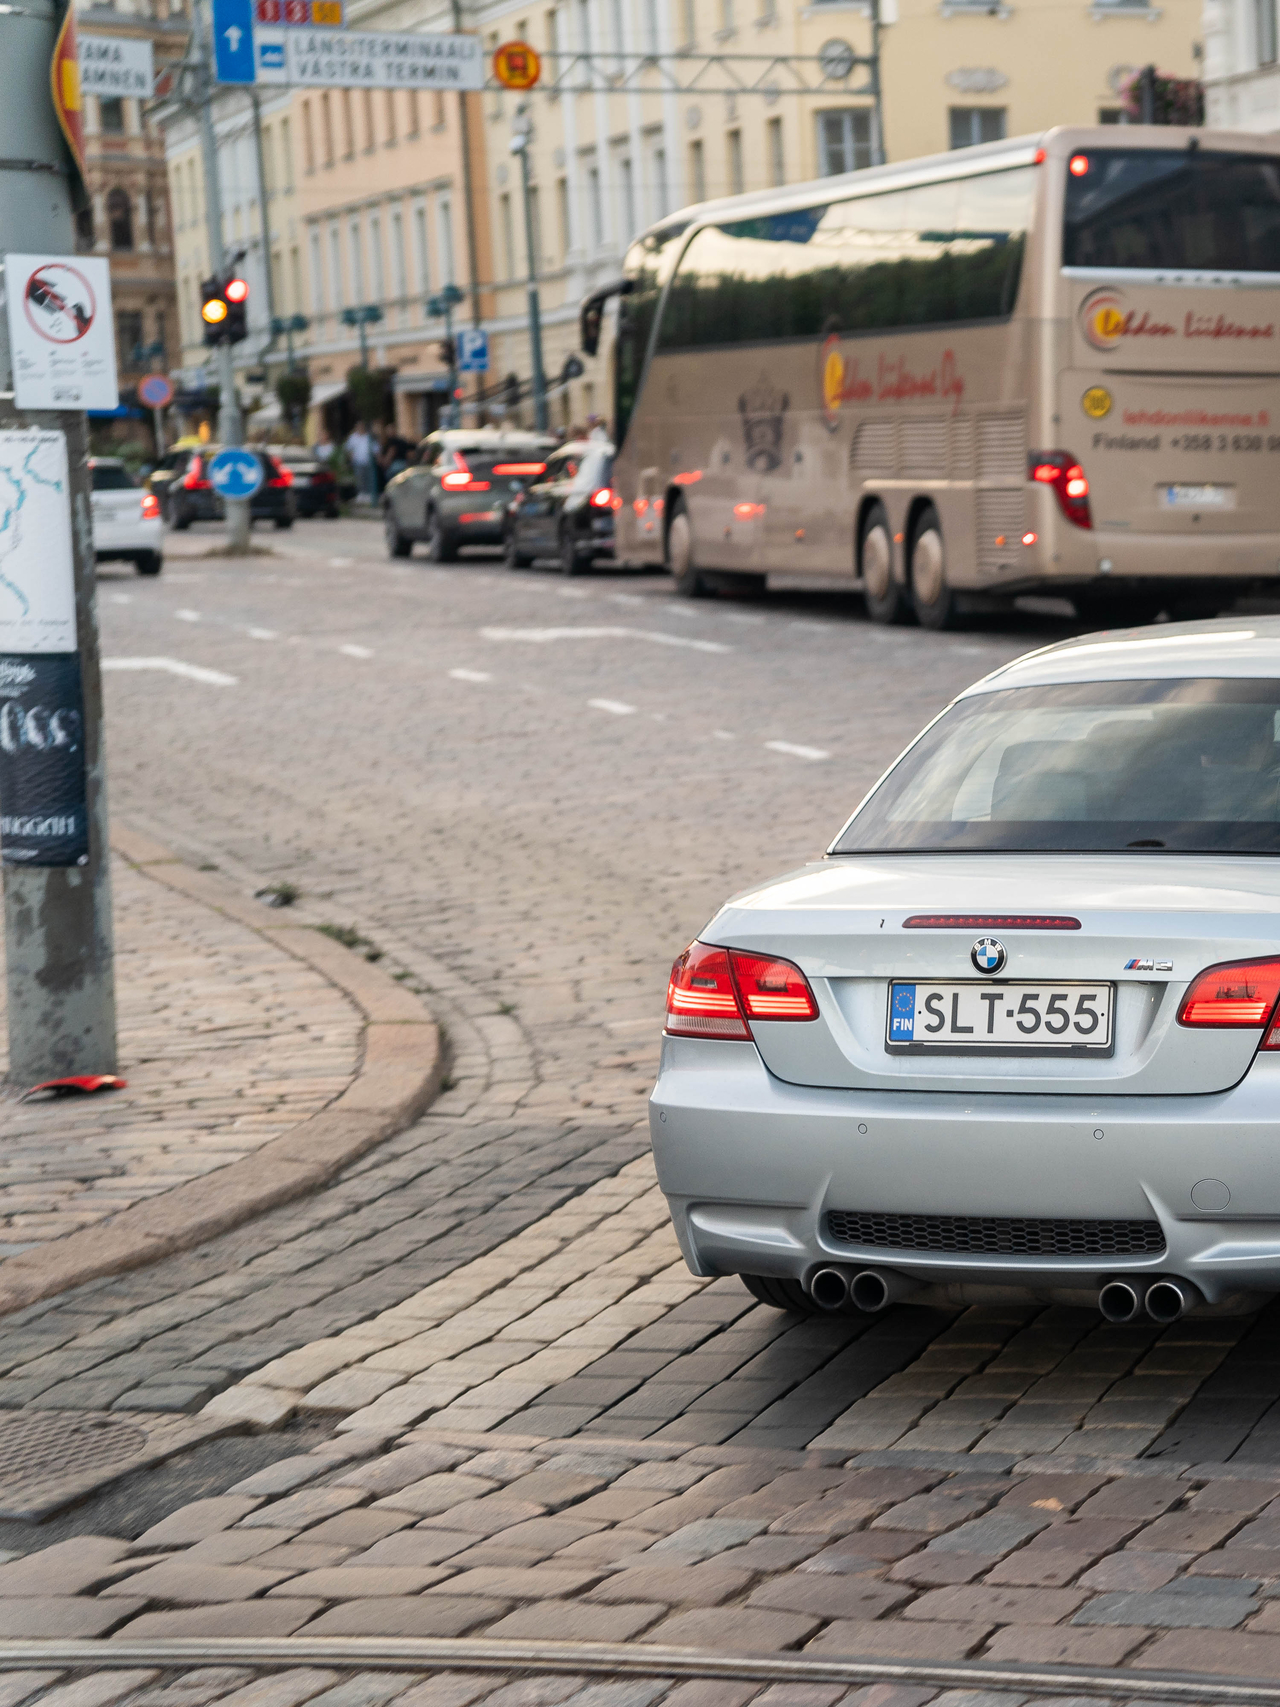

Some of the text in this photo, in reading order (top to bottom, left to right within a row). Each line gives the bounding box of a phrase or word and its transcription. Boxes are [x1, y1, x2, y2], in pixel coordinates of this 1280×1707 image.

[293, 33, 476, 60] LÄNSITERMINAALI
[299, 56, 375, 80] VÄSTRA
[1103, 308, 1176, 338] Lehdon
[1183, 310, 1273, 340] Liikenne
[1092, 432, 1161, 450] Finland
[974, 938, 1003, 951] BMW
[893, 1018, 913, 1031] FIN
[924, 992, 1099, 1034] SLT-555
